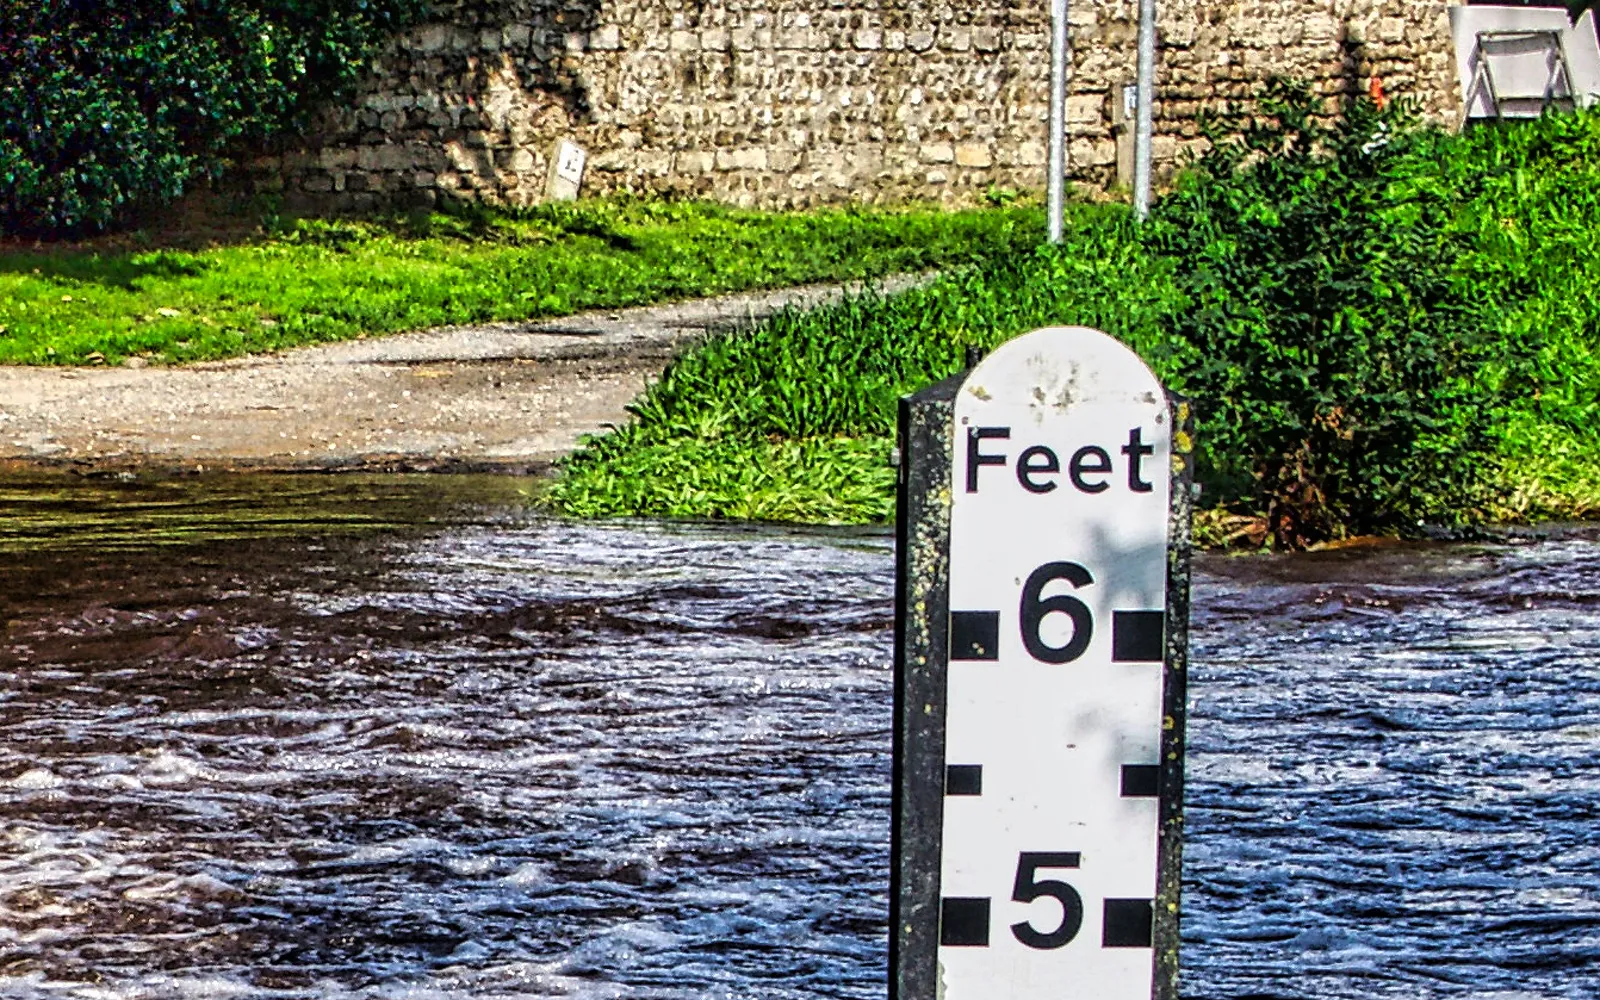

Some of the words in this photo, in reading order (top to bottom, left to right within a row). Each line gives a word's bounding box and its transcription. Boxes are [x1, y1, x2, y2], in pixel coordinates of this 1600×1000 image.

[965, 427, 1155, 494] Feet
[1019, 561, 1094, 665] 6
[1010, 851, 1084, 951] 5
